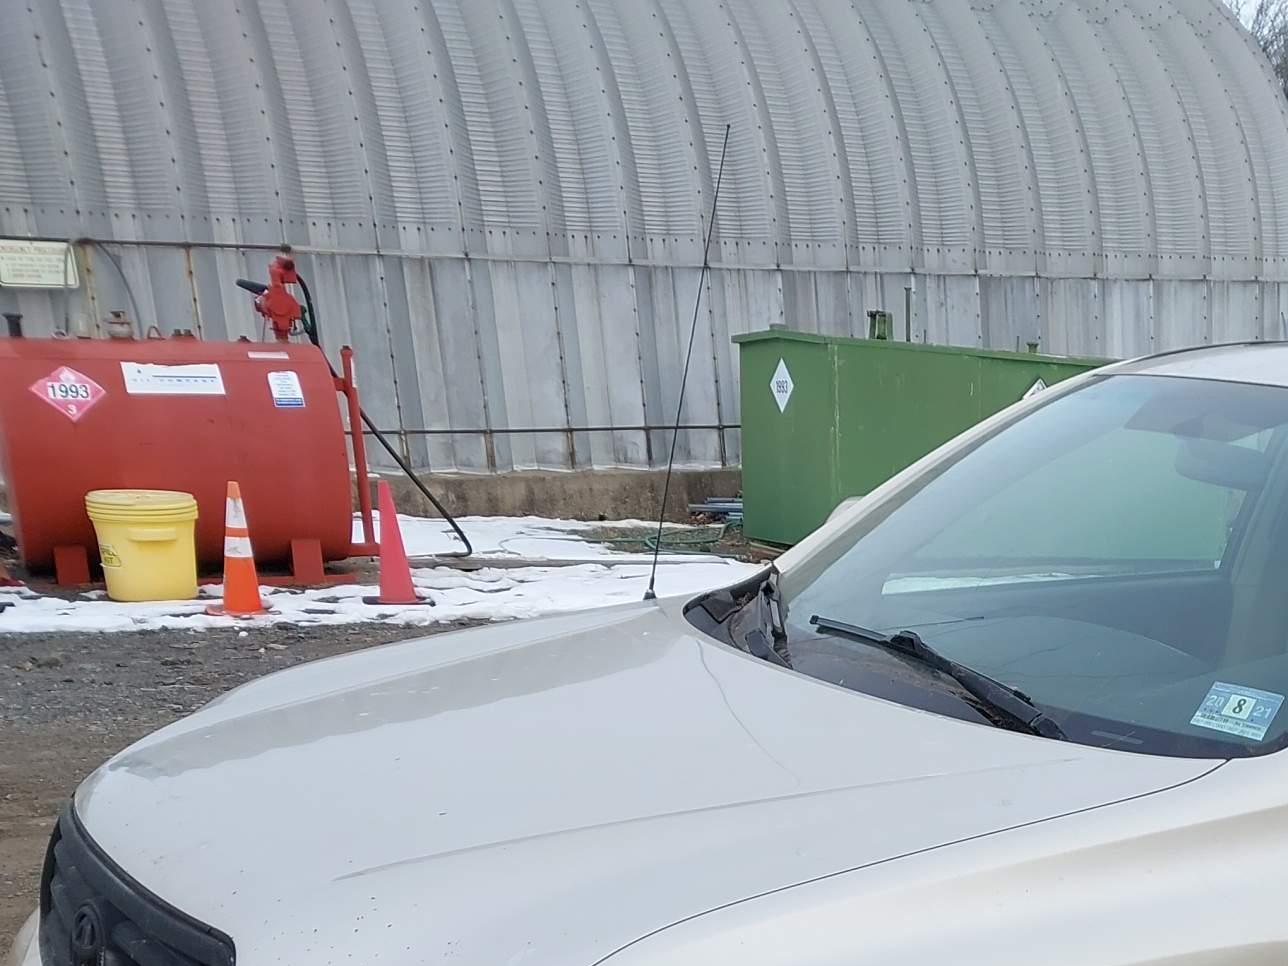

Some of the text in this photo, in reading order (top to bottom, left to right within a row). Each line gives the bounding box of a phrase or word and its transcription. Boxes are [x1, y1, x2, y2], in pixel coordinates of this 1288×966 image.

[49, 383, 90, 399] 1993
[67, 404, 77, 414] 3
[1232, 698, 1247, 714] 8
[1253, 706, 1272, 719] 21
